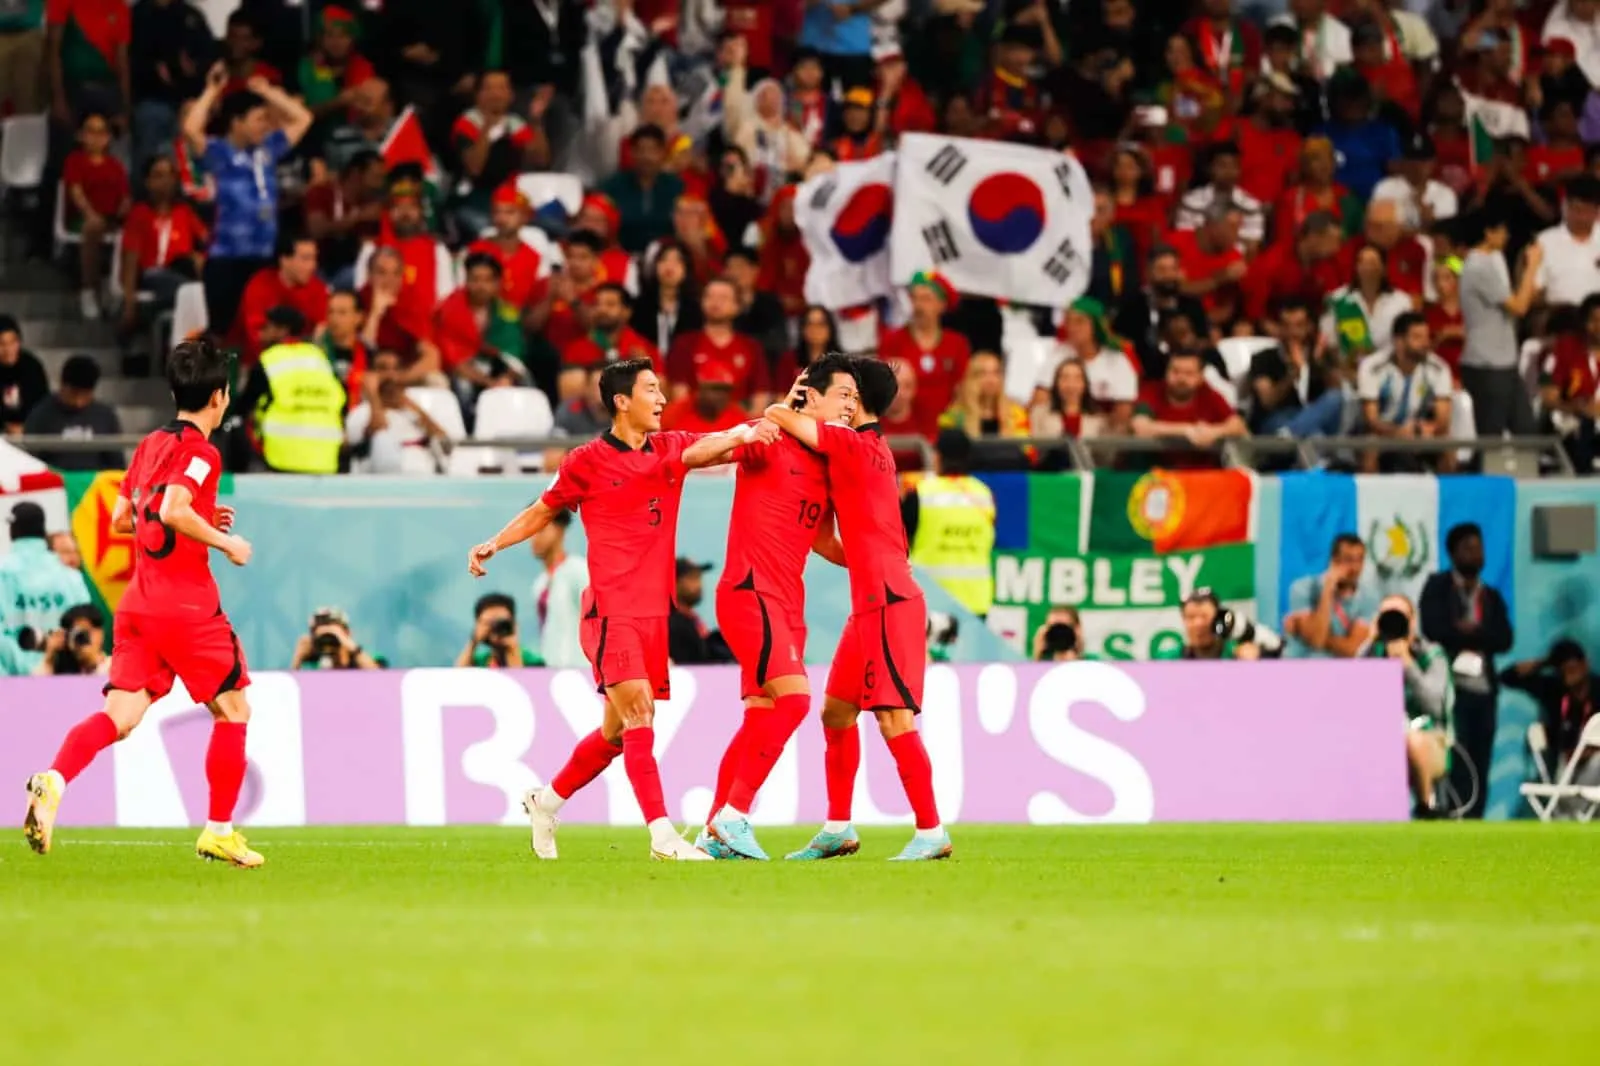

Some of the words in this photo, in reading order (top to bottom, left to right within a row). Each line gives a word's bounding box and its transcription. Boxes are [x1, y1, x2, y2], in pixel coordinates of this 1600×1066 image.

[648, 497, 662, 527] 5
[798, 499, 822, 529] 19
[400, 660, 1154, 826] BYJU'S
